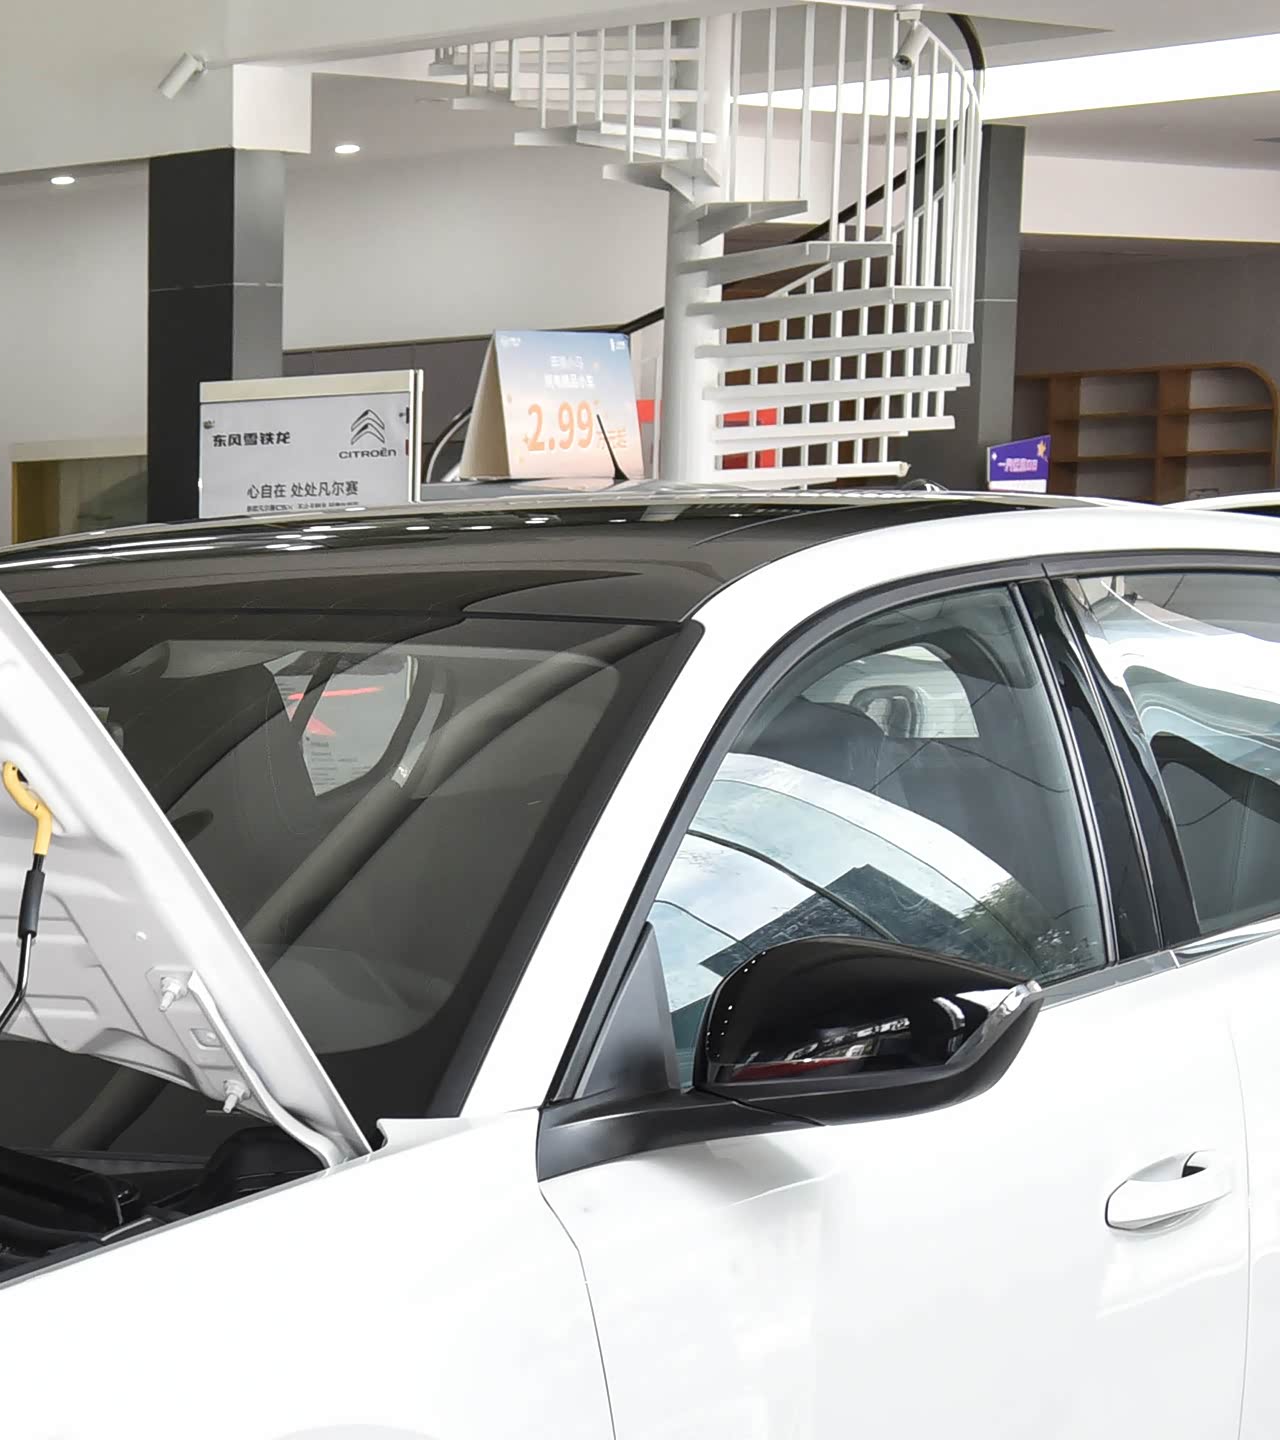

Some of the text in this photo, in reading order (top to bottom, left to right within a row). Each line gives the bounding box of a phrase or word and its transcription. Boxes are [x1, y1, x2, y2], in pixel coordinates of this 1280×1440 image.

[527, 399, 594, 452] 2.99
[212, 431, 291, 448] 东风雪铁龙
[246, 479, 360, 500] 心自在 处处凡尔赛
